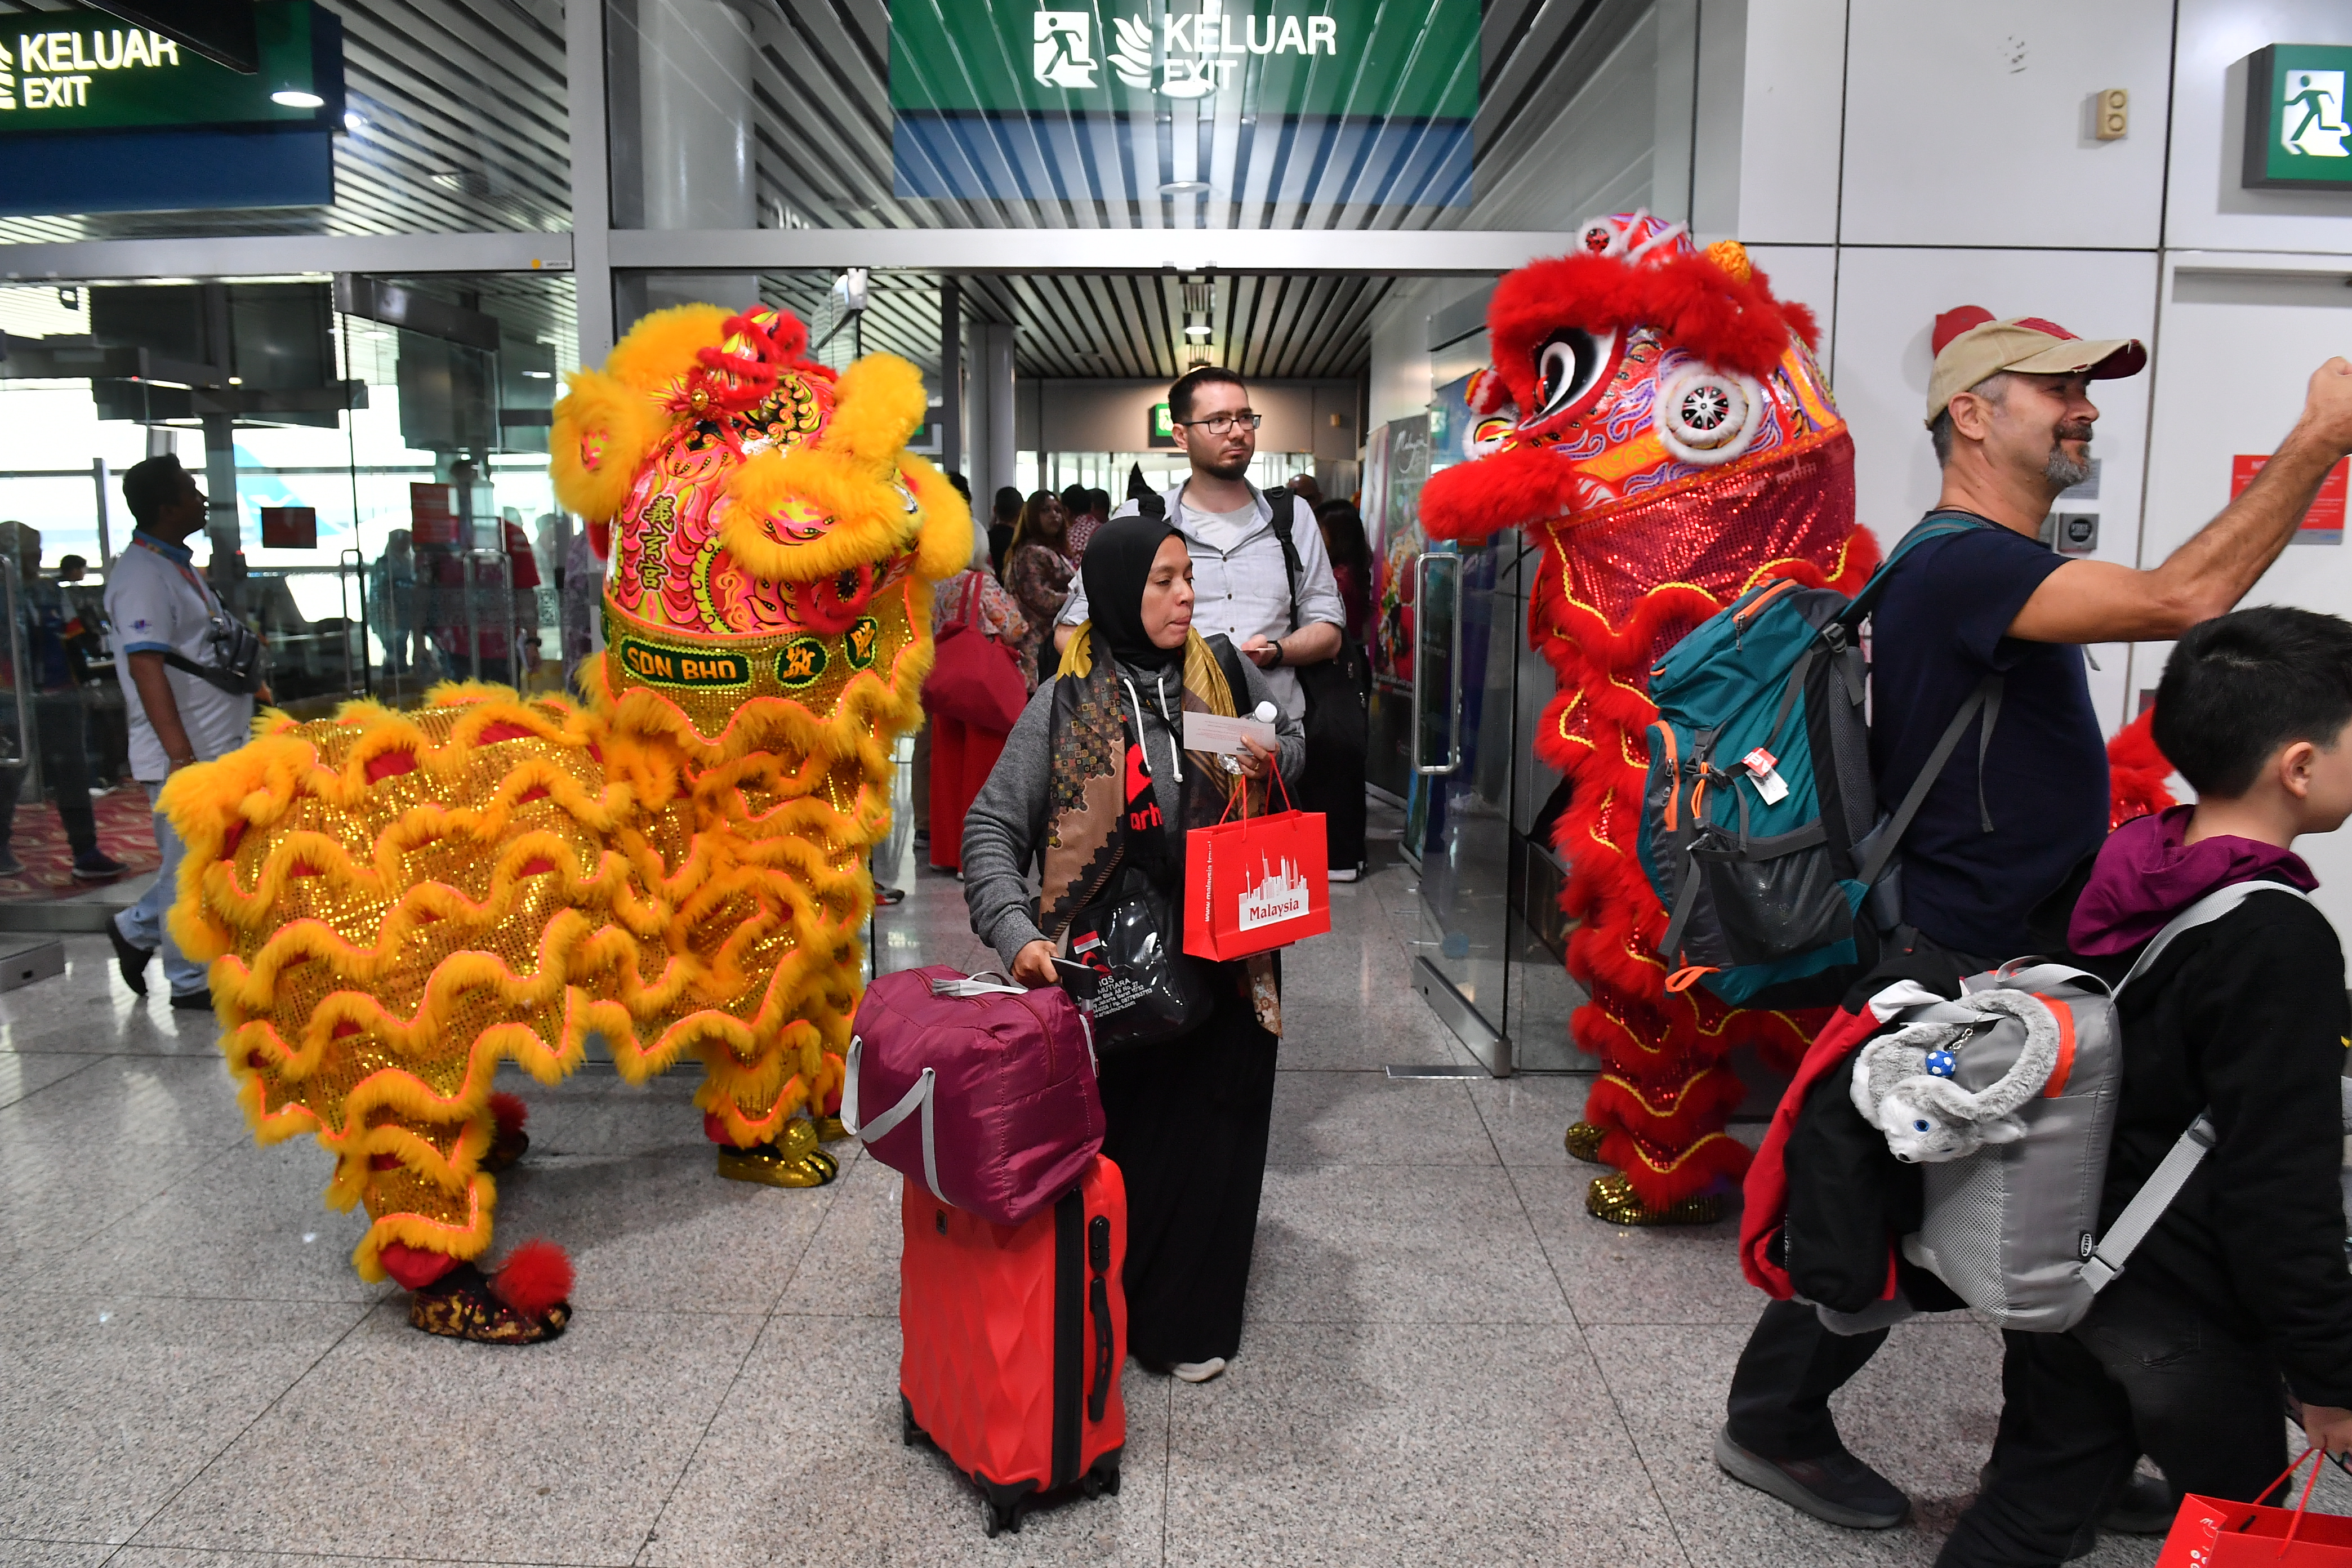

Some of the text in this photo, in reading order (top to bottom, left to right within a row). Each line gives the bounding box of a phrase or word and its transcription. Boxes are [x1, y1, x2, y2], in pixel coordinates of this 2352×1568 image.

[20, 29, 180, 72] KELUAR
[1164, 14, 1337, 55] KELUAR
[1164, 59, 1238, 90] EXIT
[23, 75, 92, 109] EXIT
[627, 647, 737, 680] SDN BHD
[1249, 898, 1299, 921] Malaysia
[1097, 978, 1131, 995] MUTIARA
